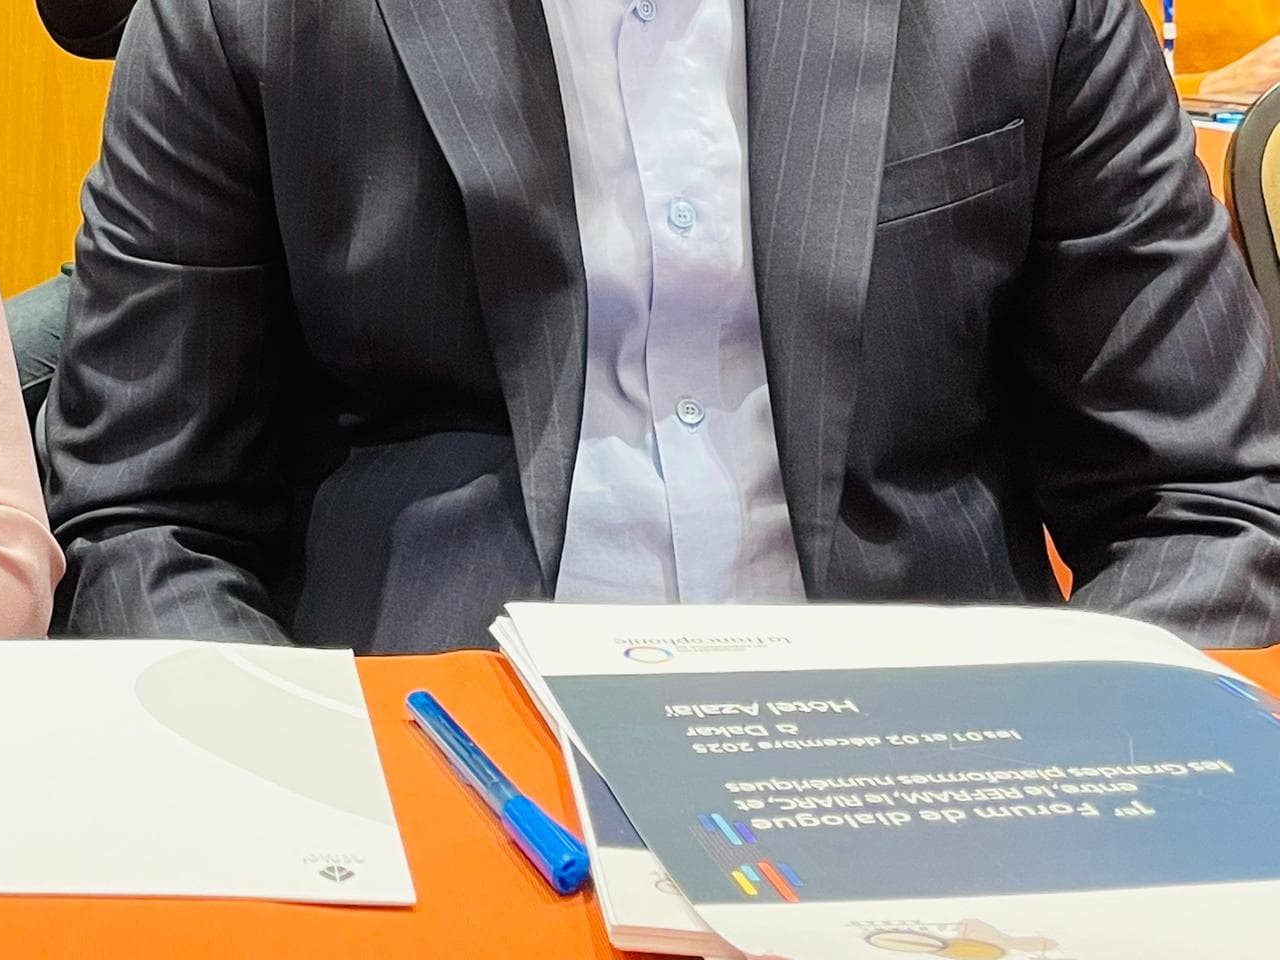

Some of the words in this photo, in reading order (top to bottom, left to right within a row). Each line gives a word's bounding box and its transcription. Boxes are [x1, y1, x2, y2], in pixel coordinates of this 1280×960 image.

[686, 724, 769, 738] Dakar
[692, 741, 755, 754] 2025
[897, 766, 1068, 785] plateformes
[1067, 763, 1189, 779] Grandes
[893, 788, 1024, 804] REFRAM,
[1023, 784, 1055, 798] le
[733, 798, 765, 811] et
[768, 794, 864, 810] RIARC,
[864, 792, 895, 806] le
[919, 808, 967, 823] de
[973, 802, 1100, 818] Forum
[750, 811, 912, 829] dialogue
